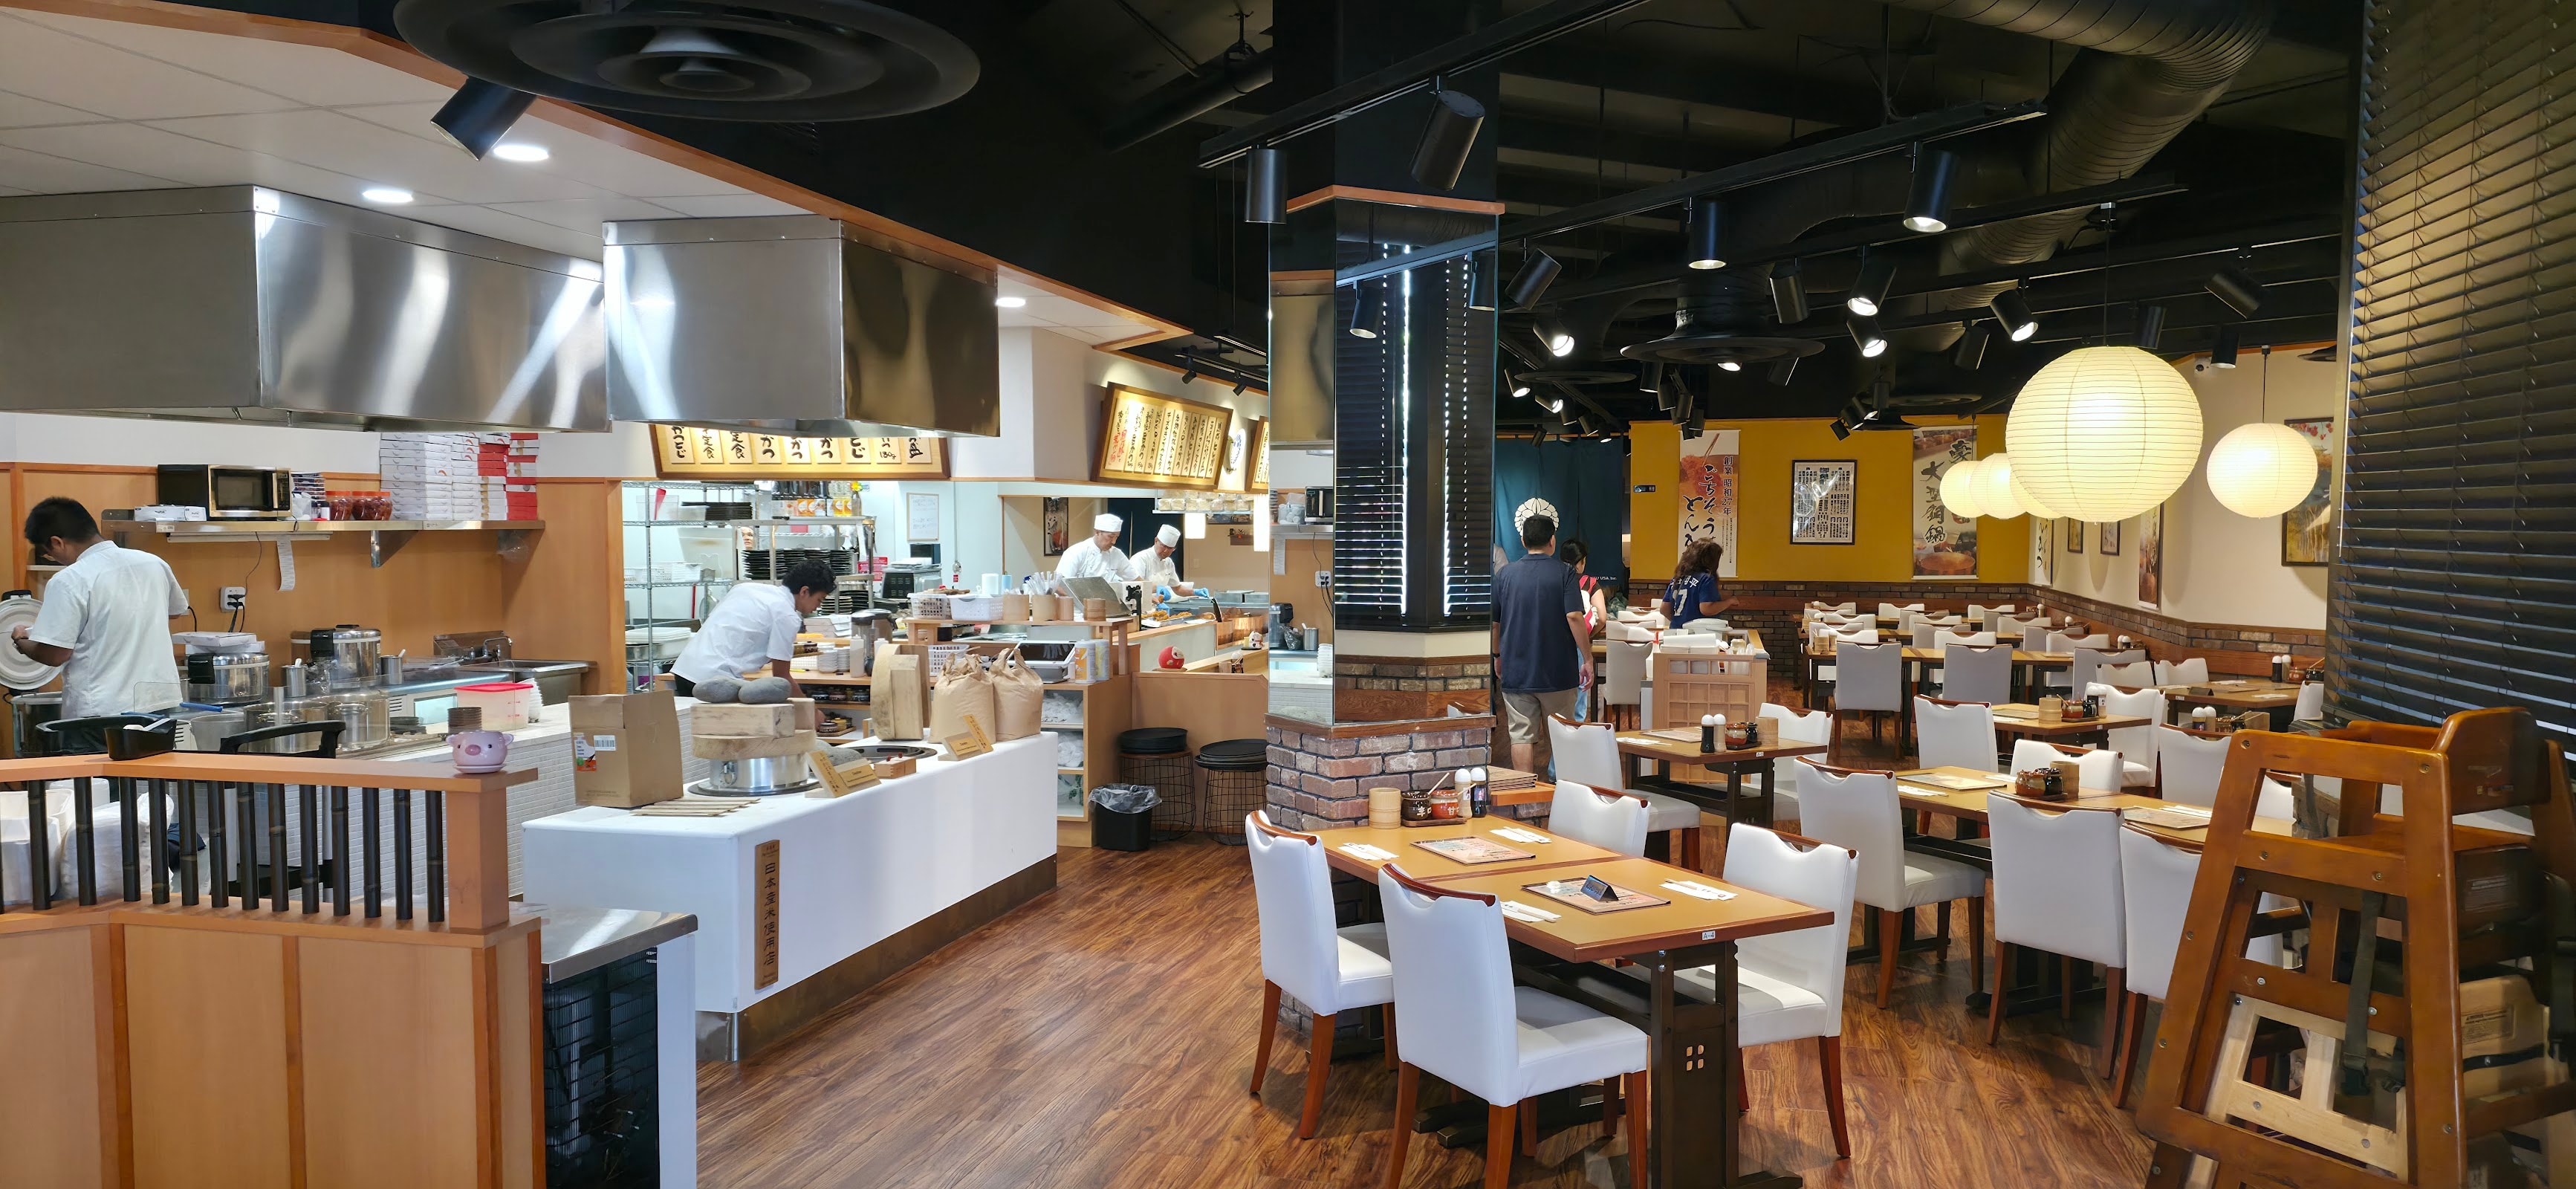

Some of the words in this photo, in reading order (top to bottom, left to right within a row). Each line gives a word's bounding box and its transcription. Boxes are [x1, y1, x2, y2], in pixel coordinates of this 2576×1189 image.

[791, 437, 802, 459] かつ
[1723, 456, 1733, 475] 創業
[1699, 464, 1719, 540] ごちそう
[1722, 479, 1733, 516] 昭和27年
[763, 862, 777, 966] 日本産米使用店
[1703, 932, 1715, 940] A-4
